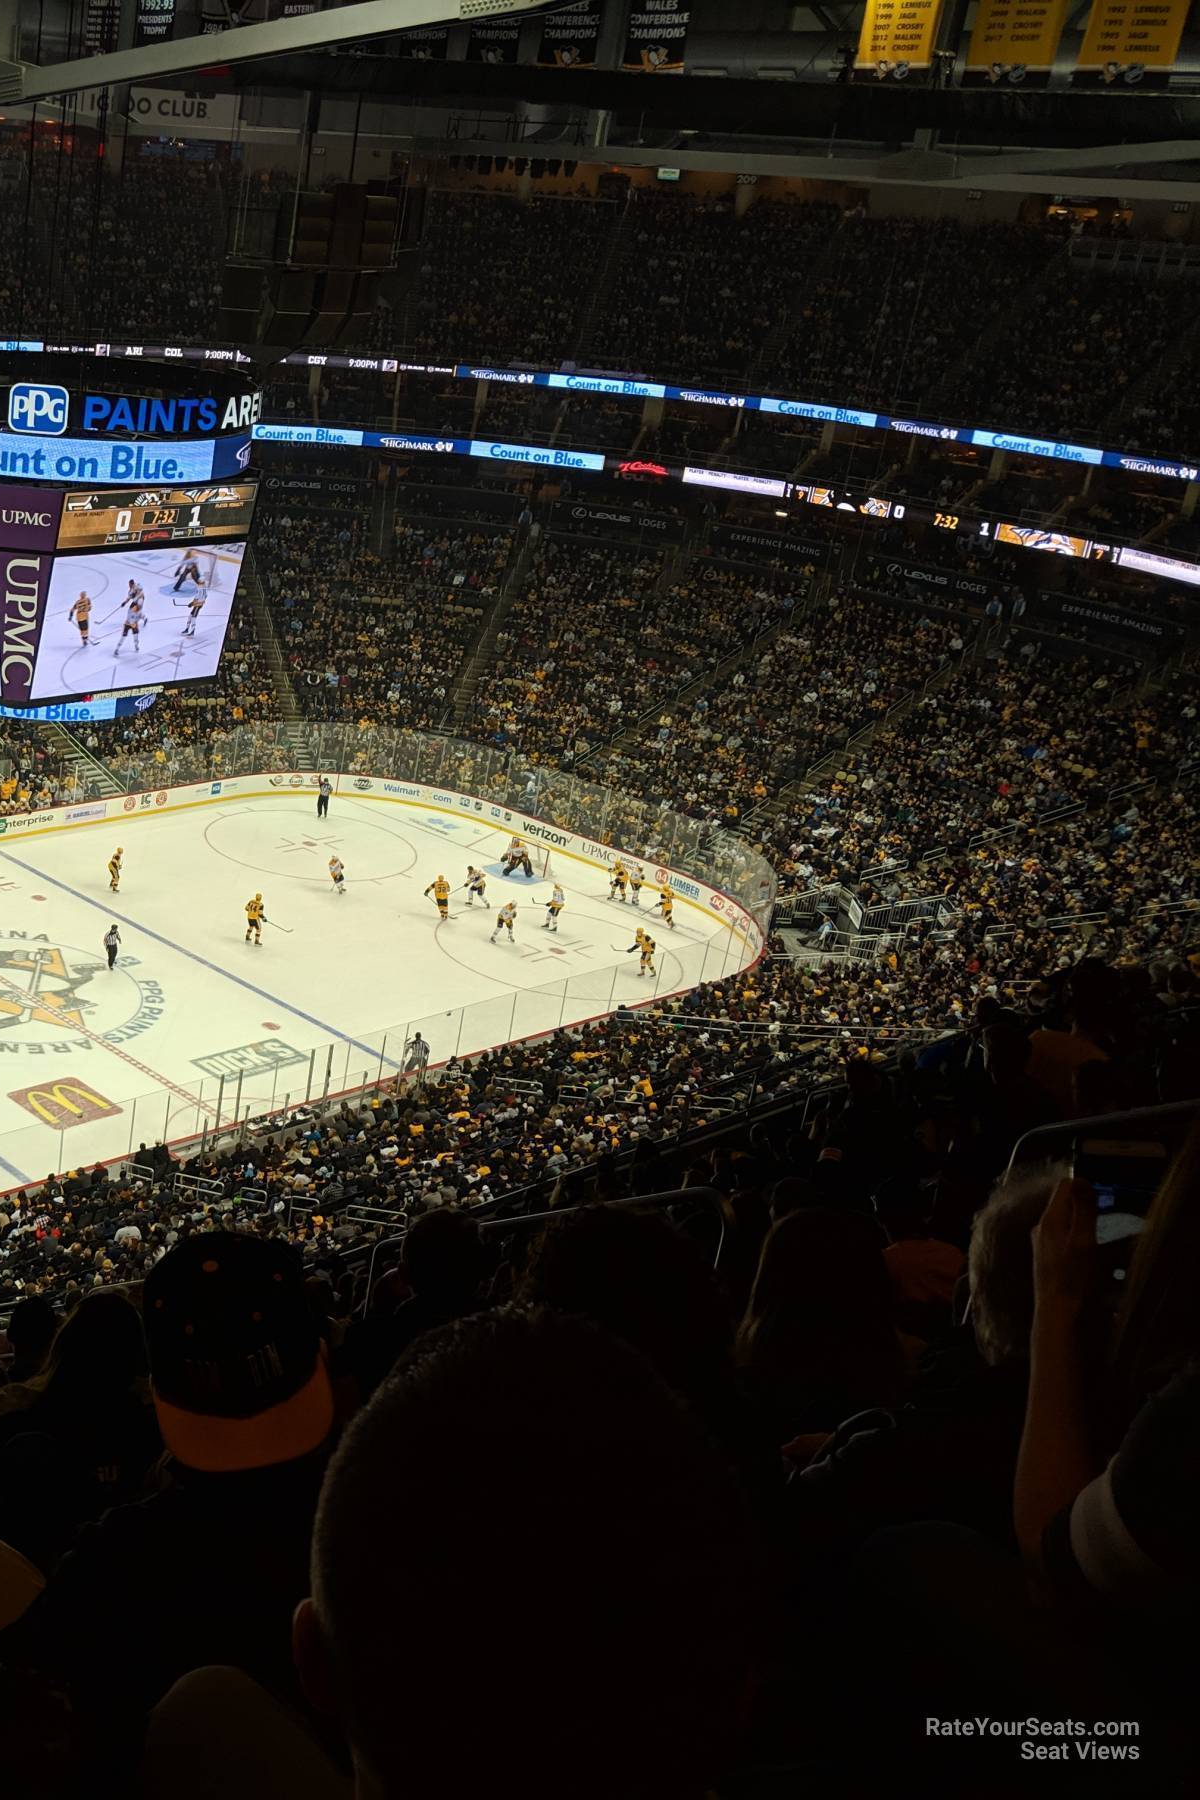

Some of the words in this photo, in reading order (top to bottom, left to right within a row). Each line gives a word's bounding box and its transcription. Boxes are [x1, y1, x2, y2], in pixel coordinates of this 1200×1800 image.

[630, 12, 690, 25] CONFERENCE
[544, 27, 597, 39] CHAMPIONS
[629, 27, 687, 40] CHAMPIONS
[158, 99, 208, 118] CLUB
[736, 174, 757, 185] 209
[126, 347, 144, 357] ARI
[165, 347, 183, 358] COL
[205, 350, 234, 361] 9:00PM
[307, 355, 328, 366] CGY
[349, 359, 378, 370] 9:00PM
[474, 370, 518, 382] HIGHMARK
[566, 376, 602, 391] Count
[604, 380, 620, 392] on
[622, 382, 652, 396] Blue.
[682, 392, 729, 407] HIGHMARK
[12, 390, 65, 429] PPG
[84, 395, 217, 432] PAINTS
[778, 402, 814, 418] Count
[818, 408, 833, 420] on
[835, 409, 862, 425] Blue.
[255, 426, 294, 442] Count
[296, 430, 313, 442] on
[315, 428, 348, 444] Blue.
[894, 422, 940, 438] HIGHMARK
[384, 438, 434, 451] HIGHMARK
[992, 433, 1031, 453] Count
[1033, 440, 1051, 454] on
[1053, 444, 1086, 462] Blue.
[57, 454, 99, 479] on
[109, 446, 185, 480] Blue.
[490, 444, 532, 462] Count
[534, 449, 551, 462] on
[554, 451, 587, 468] Blue.
[1124, 459, 1178, 478] HIGHMARK
[282, 480, 321, 490] LEXUS
[328, 483, 357, 493] LOGES
[2, 510, 52, 526] UPMC
[152, 510, 176, 524] 7:32
[189, 506, 201, 527] 1
[588, 511, 632, 523] LEXUS
[638, 517, 667, 529] LOGES
[893, 504, 905, 519] 0
[933, 511, 959, 529] 7:32
[115, 510, 132, 532] 0
[979, 522, 990, 536] 1
[730, 532, 783, 549] EXPERIENCE
[784, 541, 821, 557] AMAZING
[1095, 549, 1104, 560] 7
[903, 569, 949, 585] LEXUS
[956, 579, 988, 595] LOGES
[0, 557, 41, 687] UPMC
[1061, 603, 1122, 626] EXPERIENCE
[1122, 615, 1164, 636] AMAZING
[131, 685, 164, 696] ELECTRIC
[46, 703, 95, 721] Blue.
[383, 783, 420, 797] Walmart
[433, 793, 452, 804] com
[522, 821, 567, 847] verizon
[581, 842, 616, 863] UPMC
[656, 870, 667, 883] 84
[669, 875, 701, 896] LUMBER
[138, 979, 166, 1005] PPG
[102, 1004, 164, 1044] PAINTS
